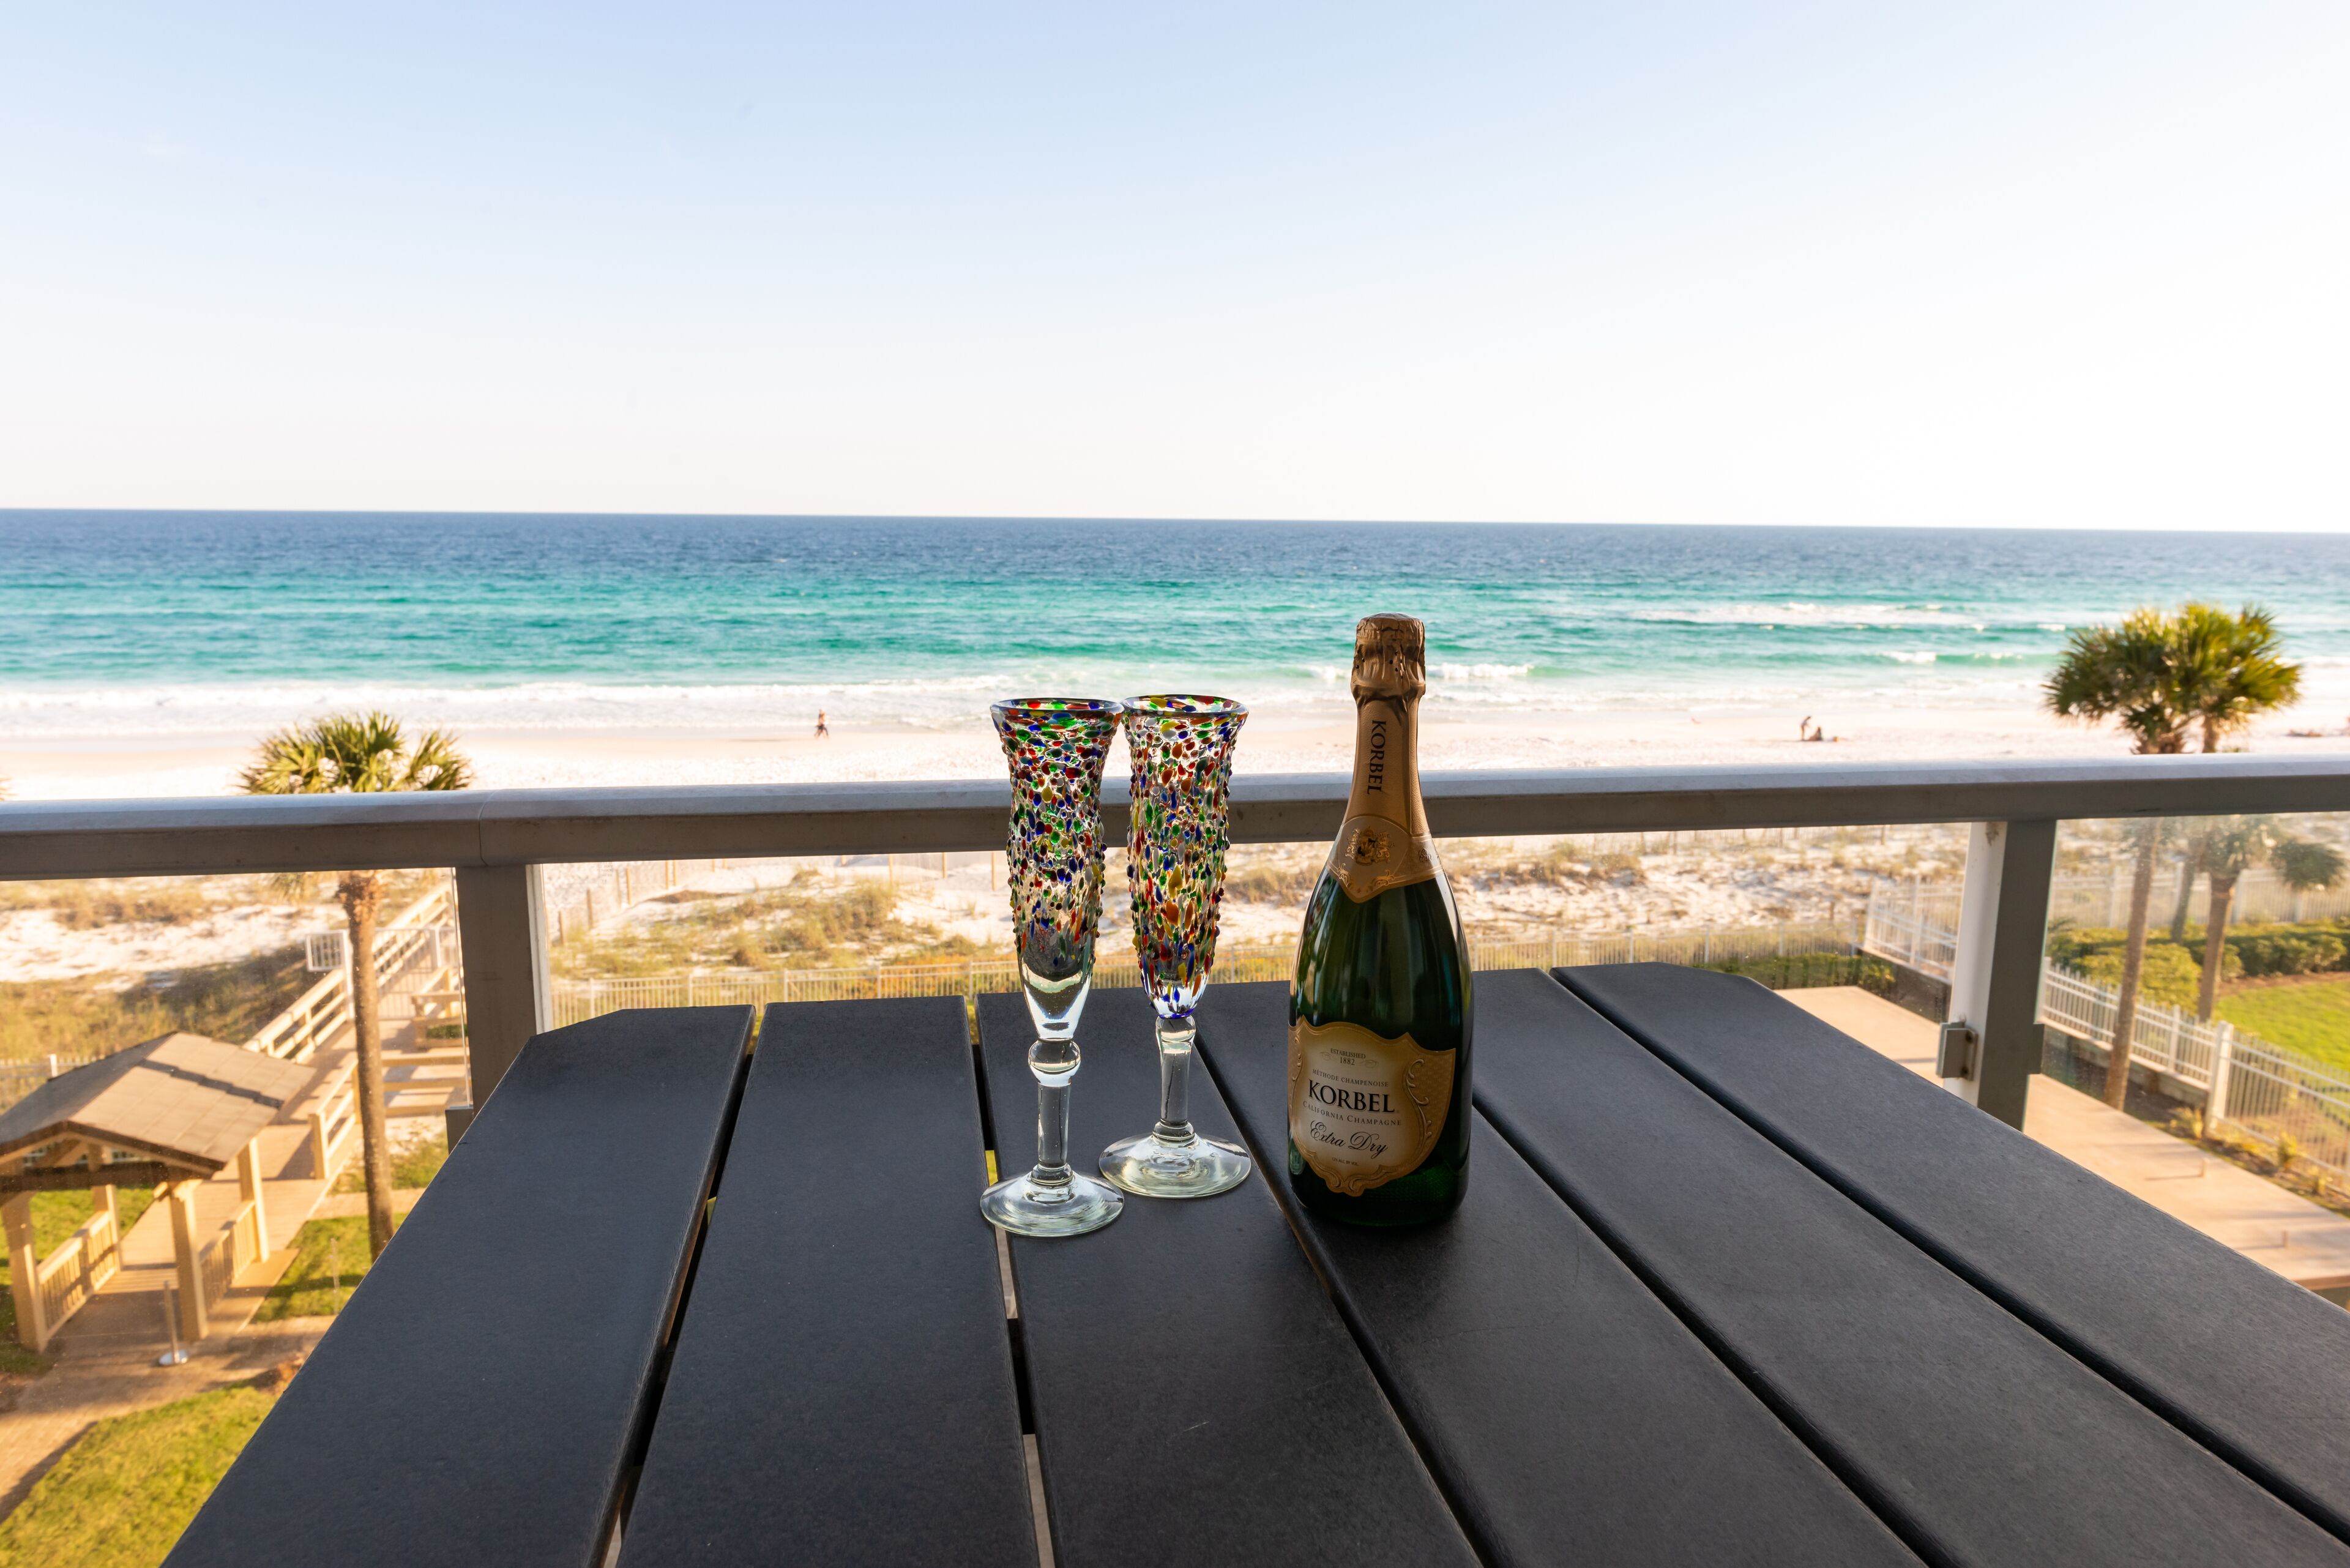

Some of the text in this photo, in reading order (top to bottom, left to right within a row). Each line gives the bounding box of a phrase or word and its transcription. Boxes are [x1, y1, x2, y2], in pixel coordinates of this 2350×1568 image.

[1367, 720, 1387, 795] KORBEL
[1330, 1048, 1366, 1059] ESTABLISHED
[1340, 1057, 1356, 1066] 1882
[1308, 1078, 1395, 1113] KORBEL
[1341, 1077, 1389, 1088] CHAMPENOISE
[1303, 1100, 1402, 1126] CALIFORNIA CHAMPAGNE
[1310, 1120, 1388, 1159] Extra Dry
